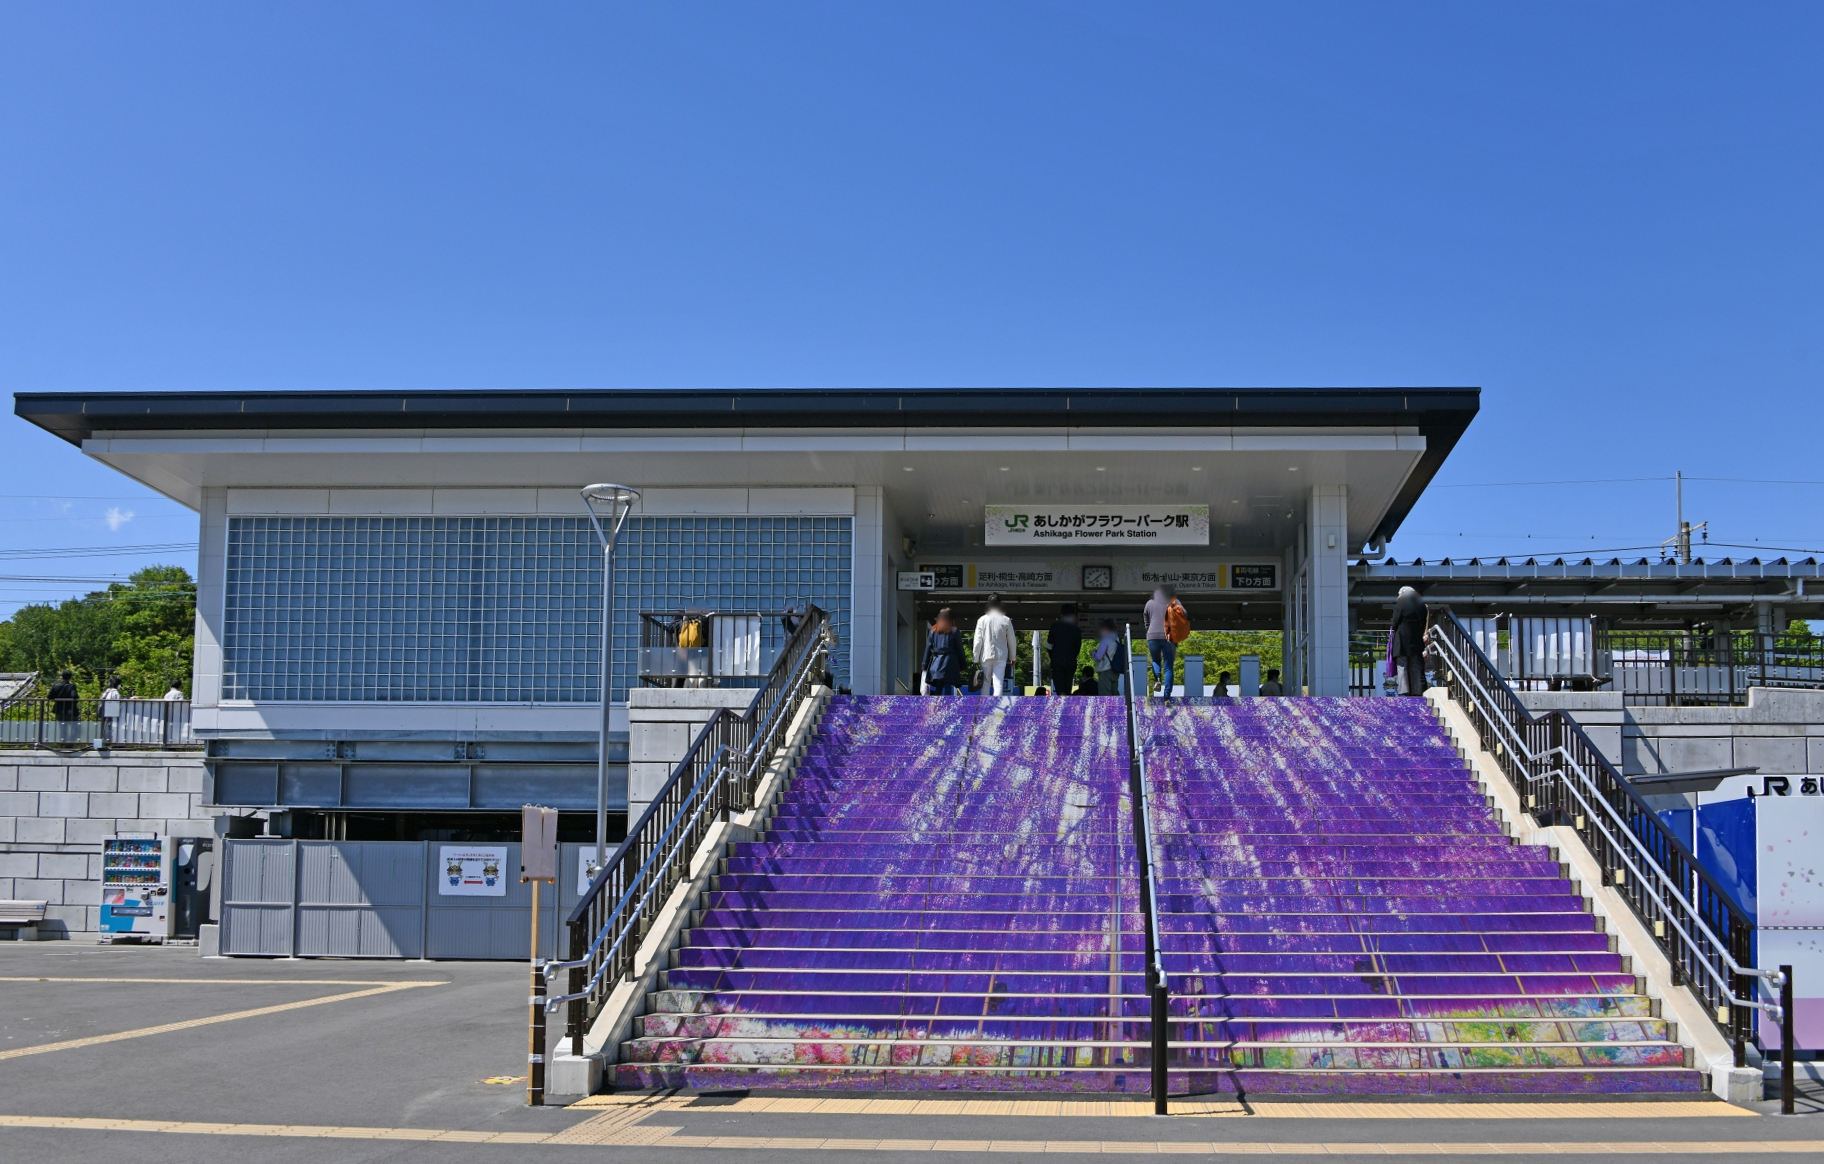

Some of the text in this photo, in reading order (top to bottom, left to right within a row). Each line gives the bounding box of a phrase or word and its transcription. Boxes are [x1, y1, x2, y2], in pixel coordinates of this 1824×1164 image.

[1004, 514, 1029, 528] JR
[1033, 514, 1189, 528] あしかがフラワーパーク駅
[1033, 529, 1157, 539] Ashikaga Flower Park Station
[1235, 576, 1272, 586] 下り方面
[1747, 776, 1789, 797] JR
